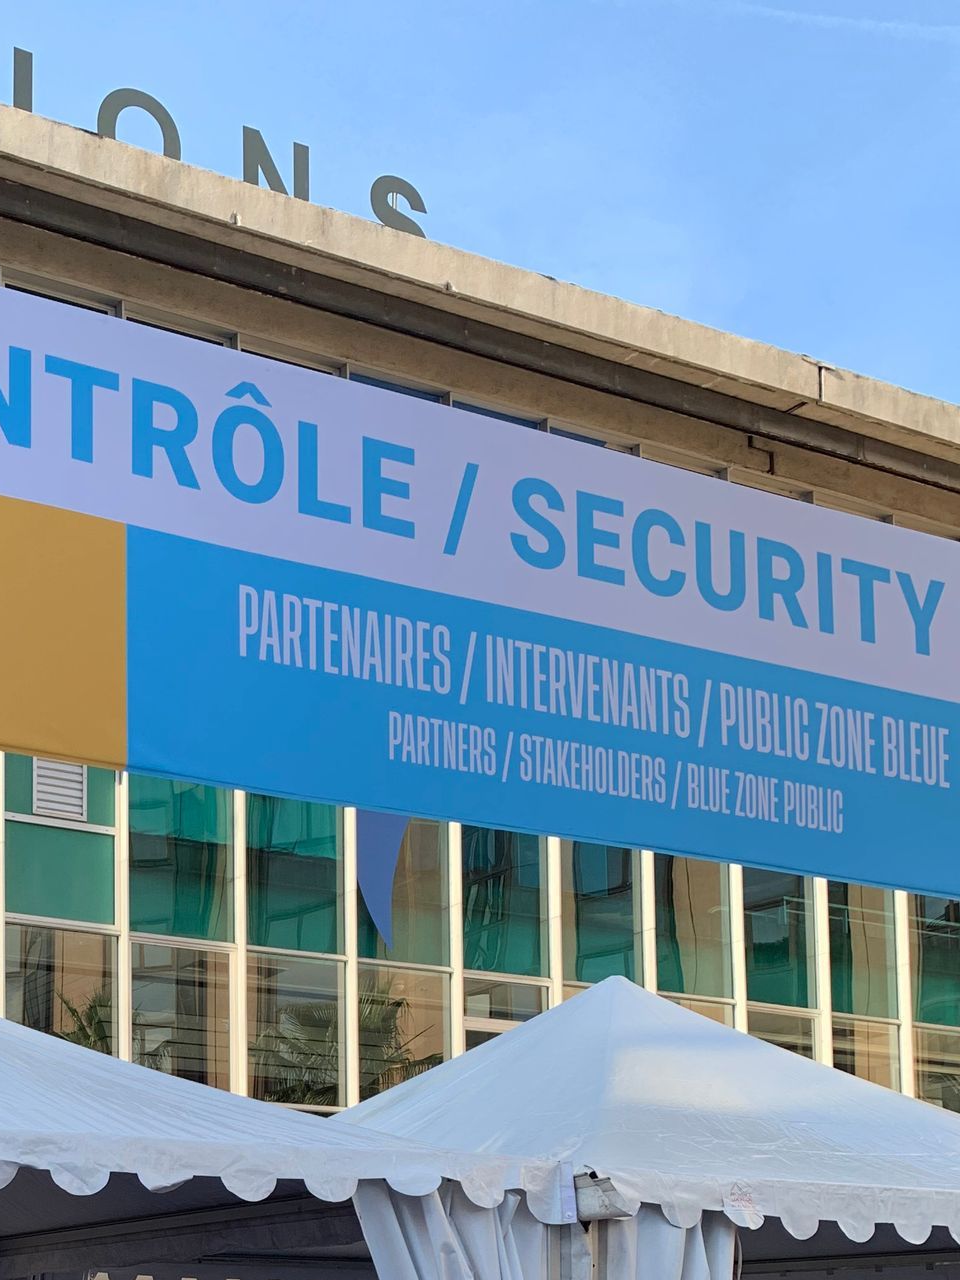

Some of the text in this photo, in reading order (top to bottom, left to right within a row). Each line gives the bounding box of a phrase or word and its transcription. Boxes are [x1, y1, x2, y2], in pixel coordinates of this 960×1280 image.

[442, 462, 479, 556] /
[509, 477, 946, 656] SECURITY
[239, 584, 951, 788] PARTENAIRES / INTERVENANTS / PUBLIC ZONE BLEUE
[389, 711, 844, 834] PARTNERS / STAKEHOLDERS / BLUE ZONE PUBLIC
